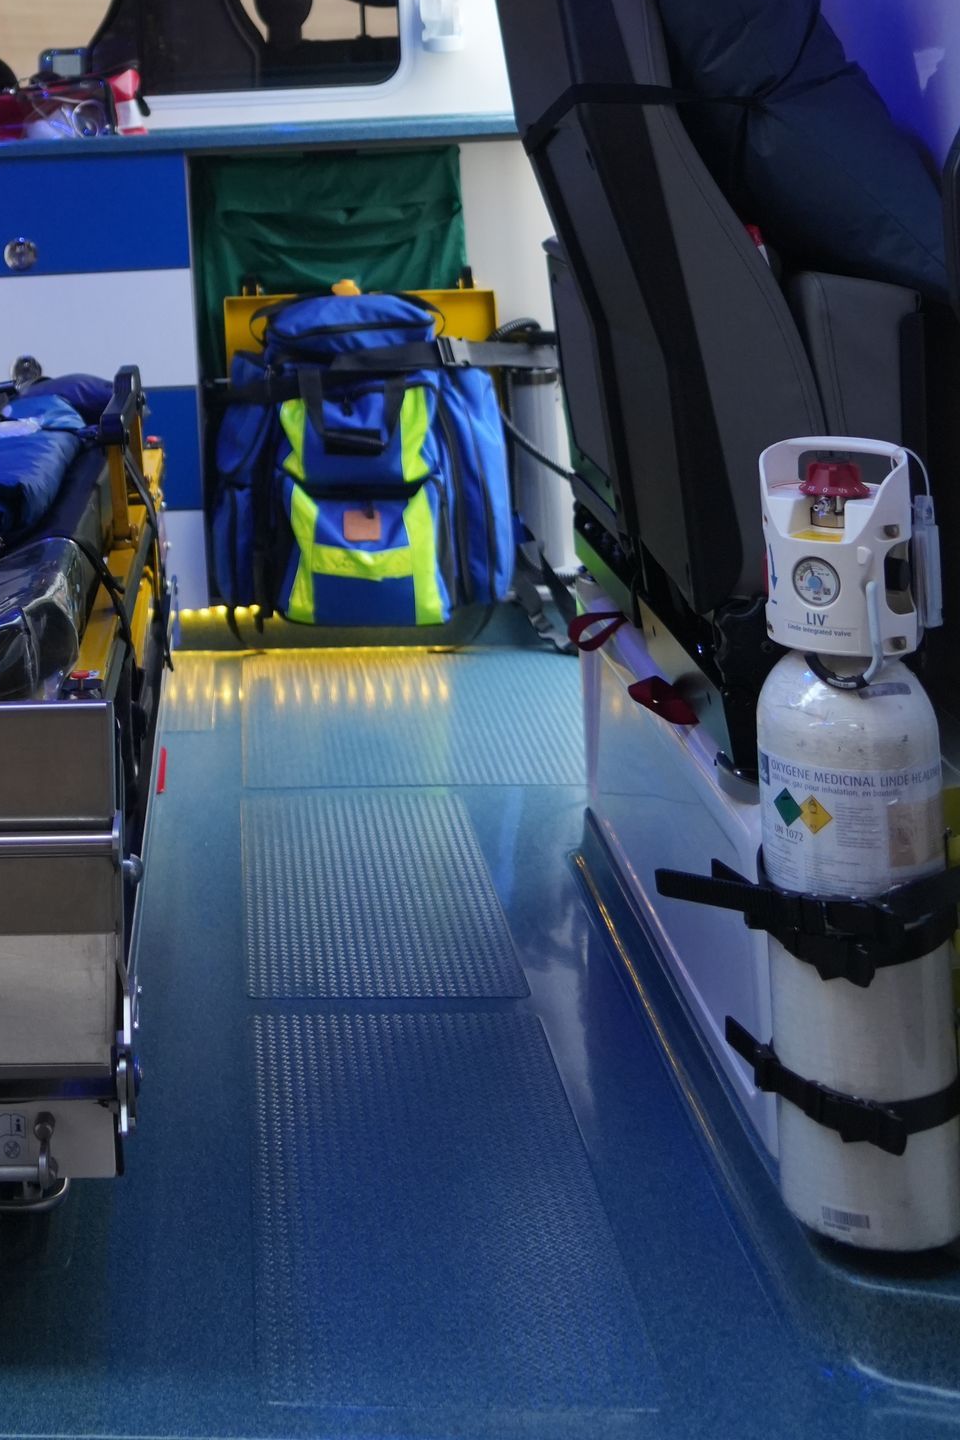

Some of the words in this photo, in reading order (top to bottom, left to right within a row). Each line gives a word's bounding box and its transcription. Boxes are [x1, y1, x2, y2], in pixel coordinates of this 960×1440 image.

[787, 623, 802, 631] Linde
[802, 626, 833, 637] integrated
[770, 760, 810, 781] OXYGENE
[814, 772, 876, 788] MEDICINAL
[880, 774, 910, 788] LINDE
[804, 783, 820, 793] pour
[774, 823, 784, 835] UN
[785, 825, 804, 842] 1072
